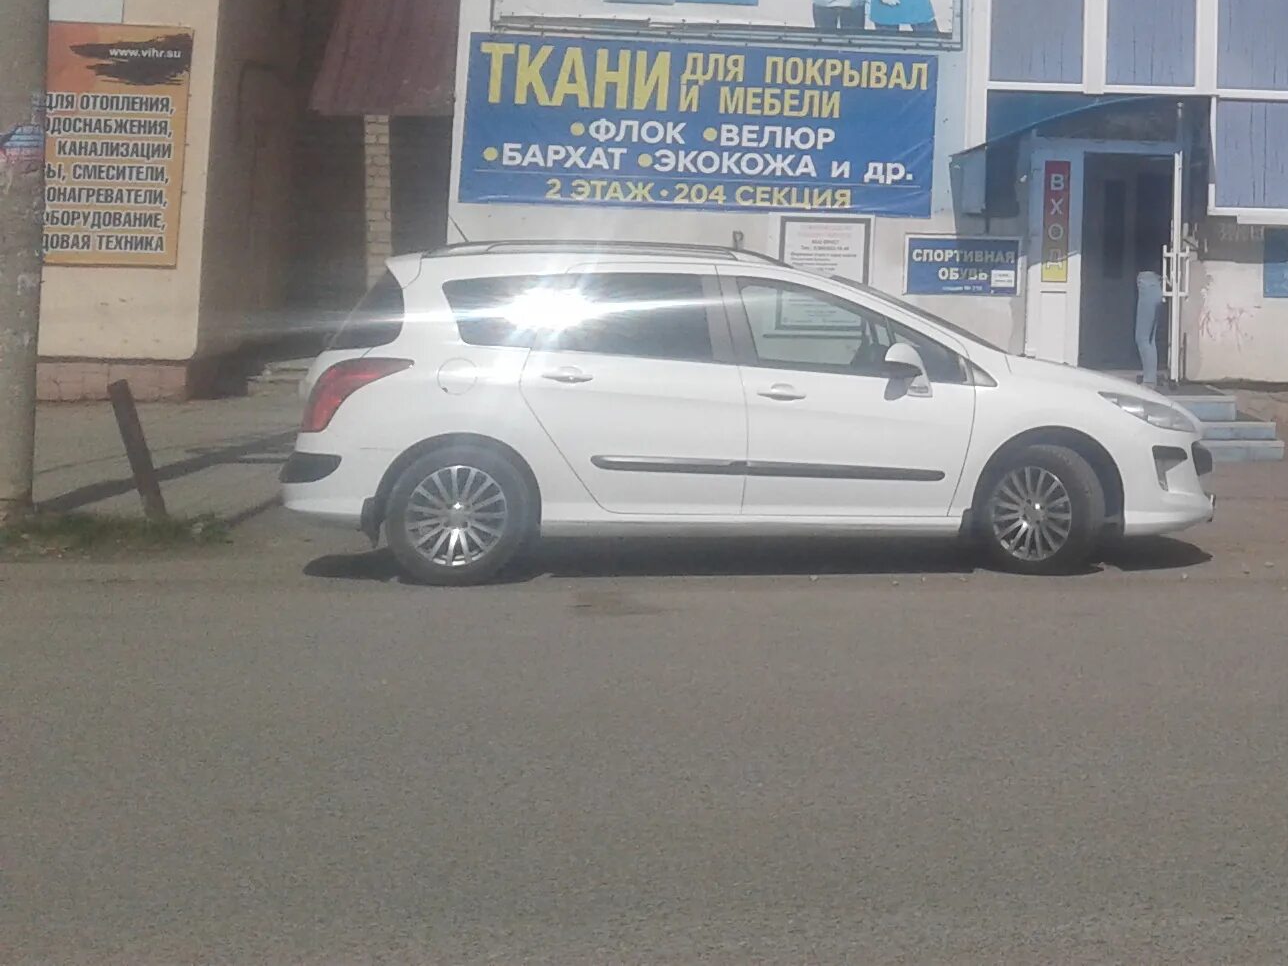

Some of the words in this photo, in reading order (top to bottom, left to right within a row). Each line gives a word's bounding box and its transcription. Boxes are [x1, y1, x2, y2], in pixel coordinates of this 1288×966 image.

[109, 47, 181, 58] www.vihr.su
[480, 41, 673, 113] ТКАНИ
[680, 51, 746, 84] ДЛЯ
[765, 55, 929, 92] ПОКРЫВАЛ
[80, 95, 174, 114] ОТОПЛЕНИЯ,
[679, 83, 699, 114] И
[718, 87, 842, 120] МЕБЕЛИ
[588, 118, 687, 146] ФЛОК
[720, 125, 836, 151] ВЕЛЮР
[57, 140, 171, 160] КАНАЛИЗАЦИИ
[73, 164, 169, 183] СМЕСИТЕЛИ,
[501, 143, 627, 172] БАРХАТ
[653, 149, 817, 179] ЭКОКОЖА
[863, 159, 915, 186] др.
[544, 178, 562, 201] 2
[570, 179, 656, 204] ЭТАЖ
[673, 182, 727, 206] 204
[735, 185, 853, 211] СЕКЦИЯ
[1047, 173, 1065, 269] ВХОД
[98, 235, 164, 252] ТЕХНИКА
[912, 248, 1015, 263] СПОРТИВНАЯ
[938, 267, 988, 281] ОБУВЬ
